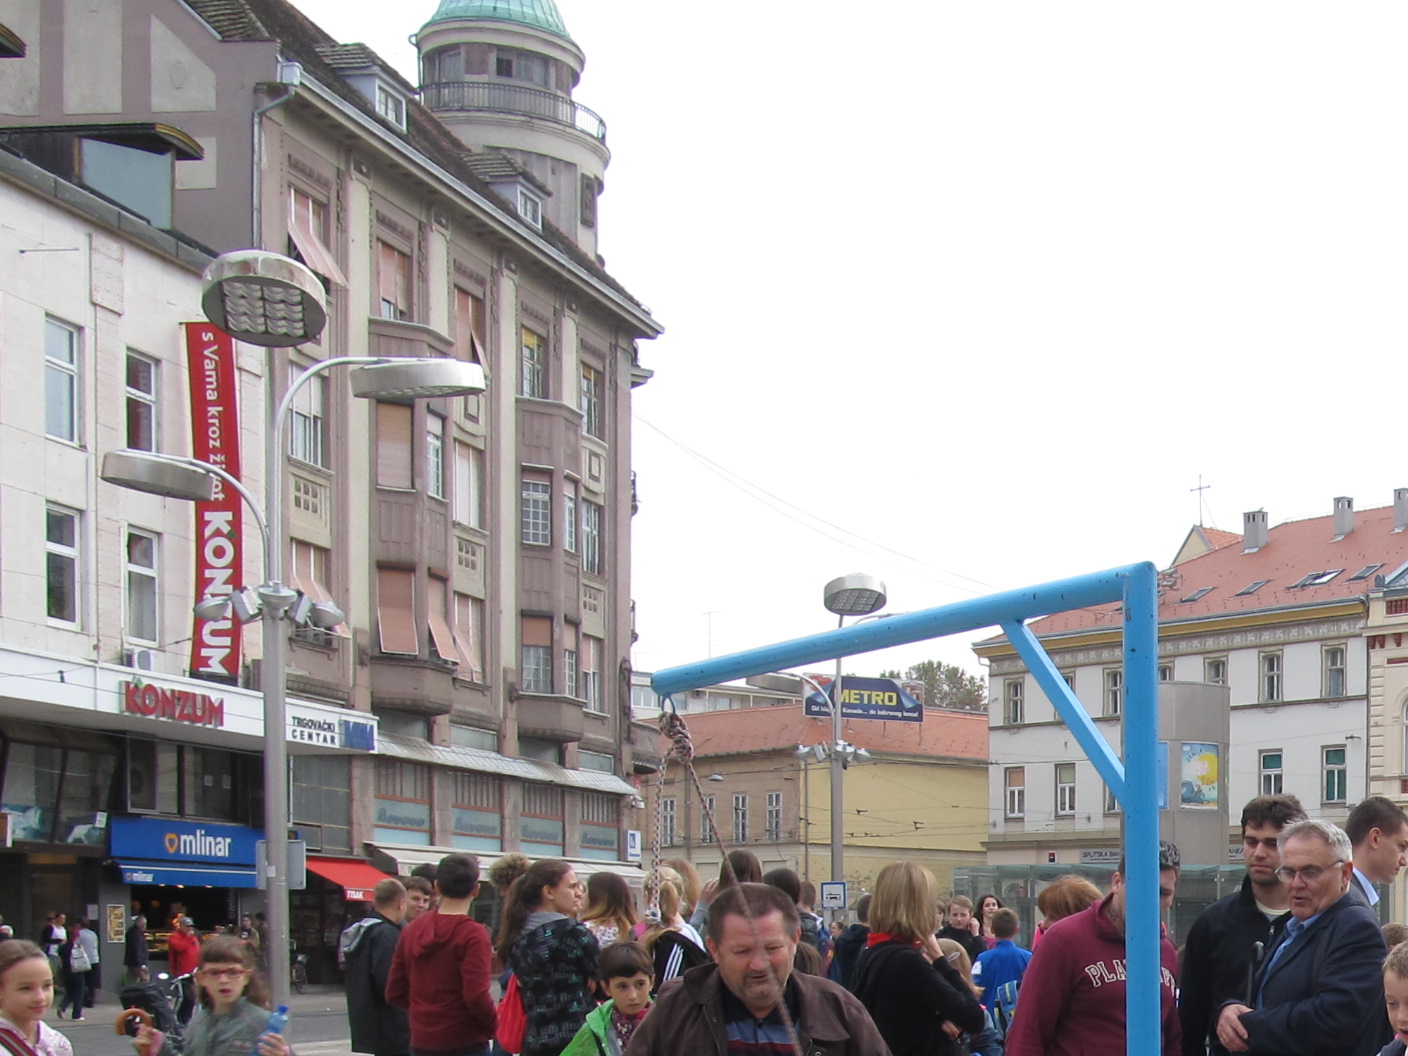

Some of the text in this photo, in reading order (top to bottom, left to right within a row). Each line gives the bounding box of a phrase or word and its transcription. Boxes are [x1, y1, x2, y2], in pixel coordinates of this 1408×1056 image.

[201, 331, 214, 342] s
[202, 345, 220, 401] Vama
[206, 406, 224, 449] kroz
[199, 511, 235, 675] KONUM
[121, 679, 225, 728] KONZUM
[291, 715, 336, 733] TRGOVAČKI
[291, 728, 336, 746] CENTAR
[180, 829, 231, 858] mlinar
